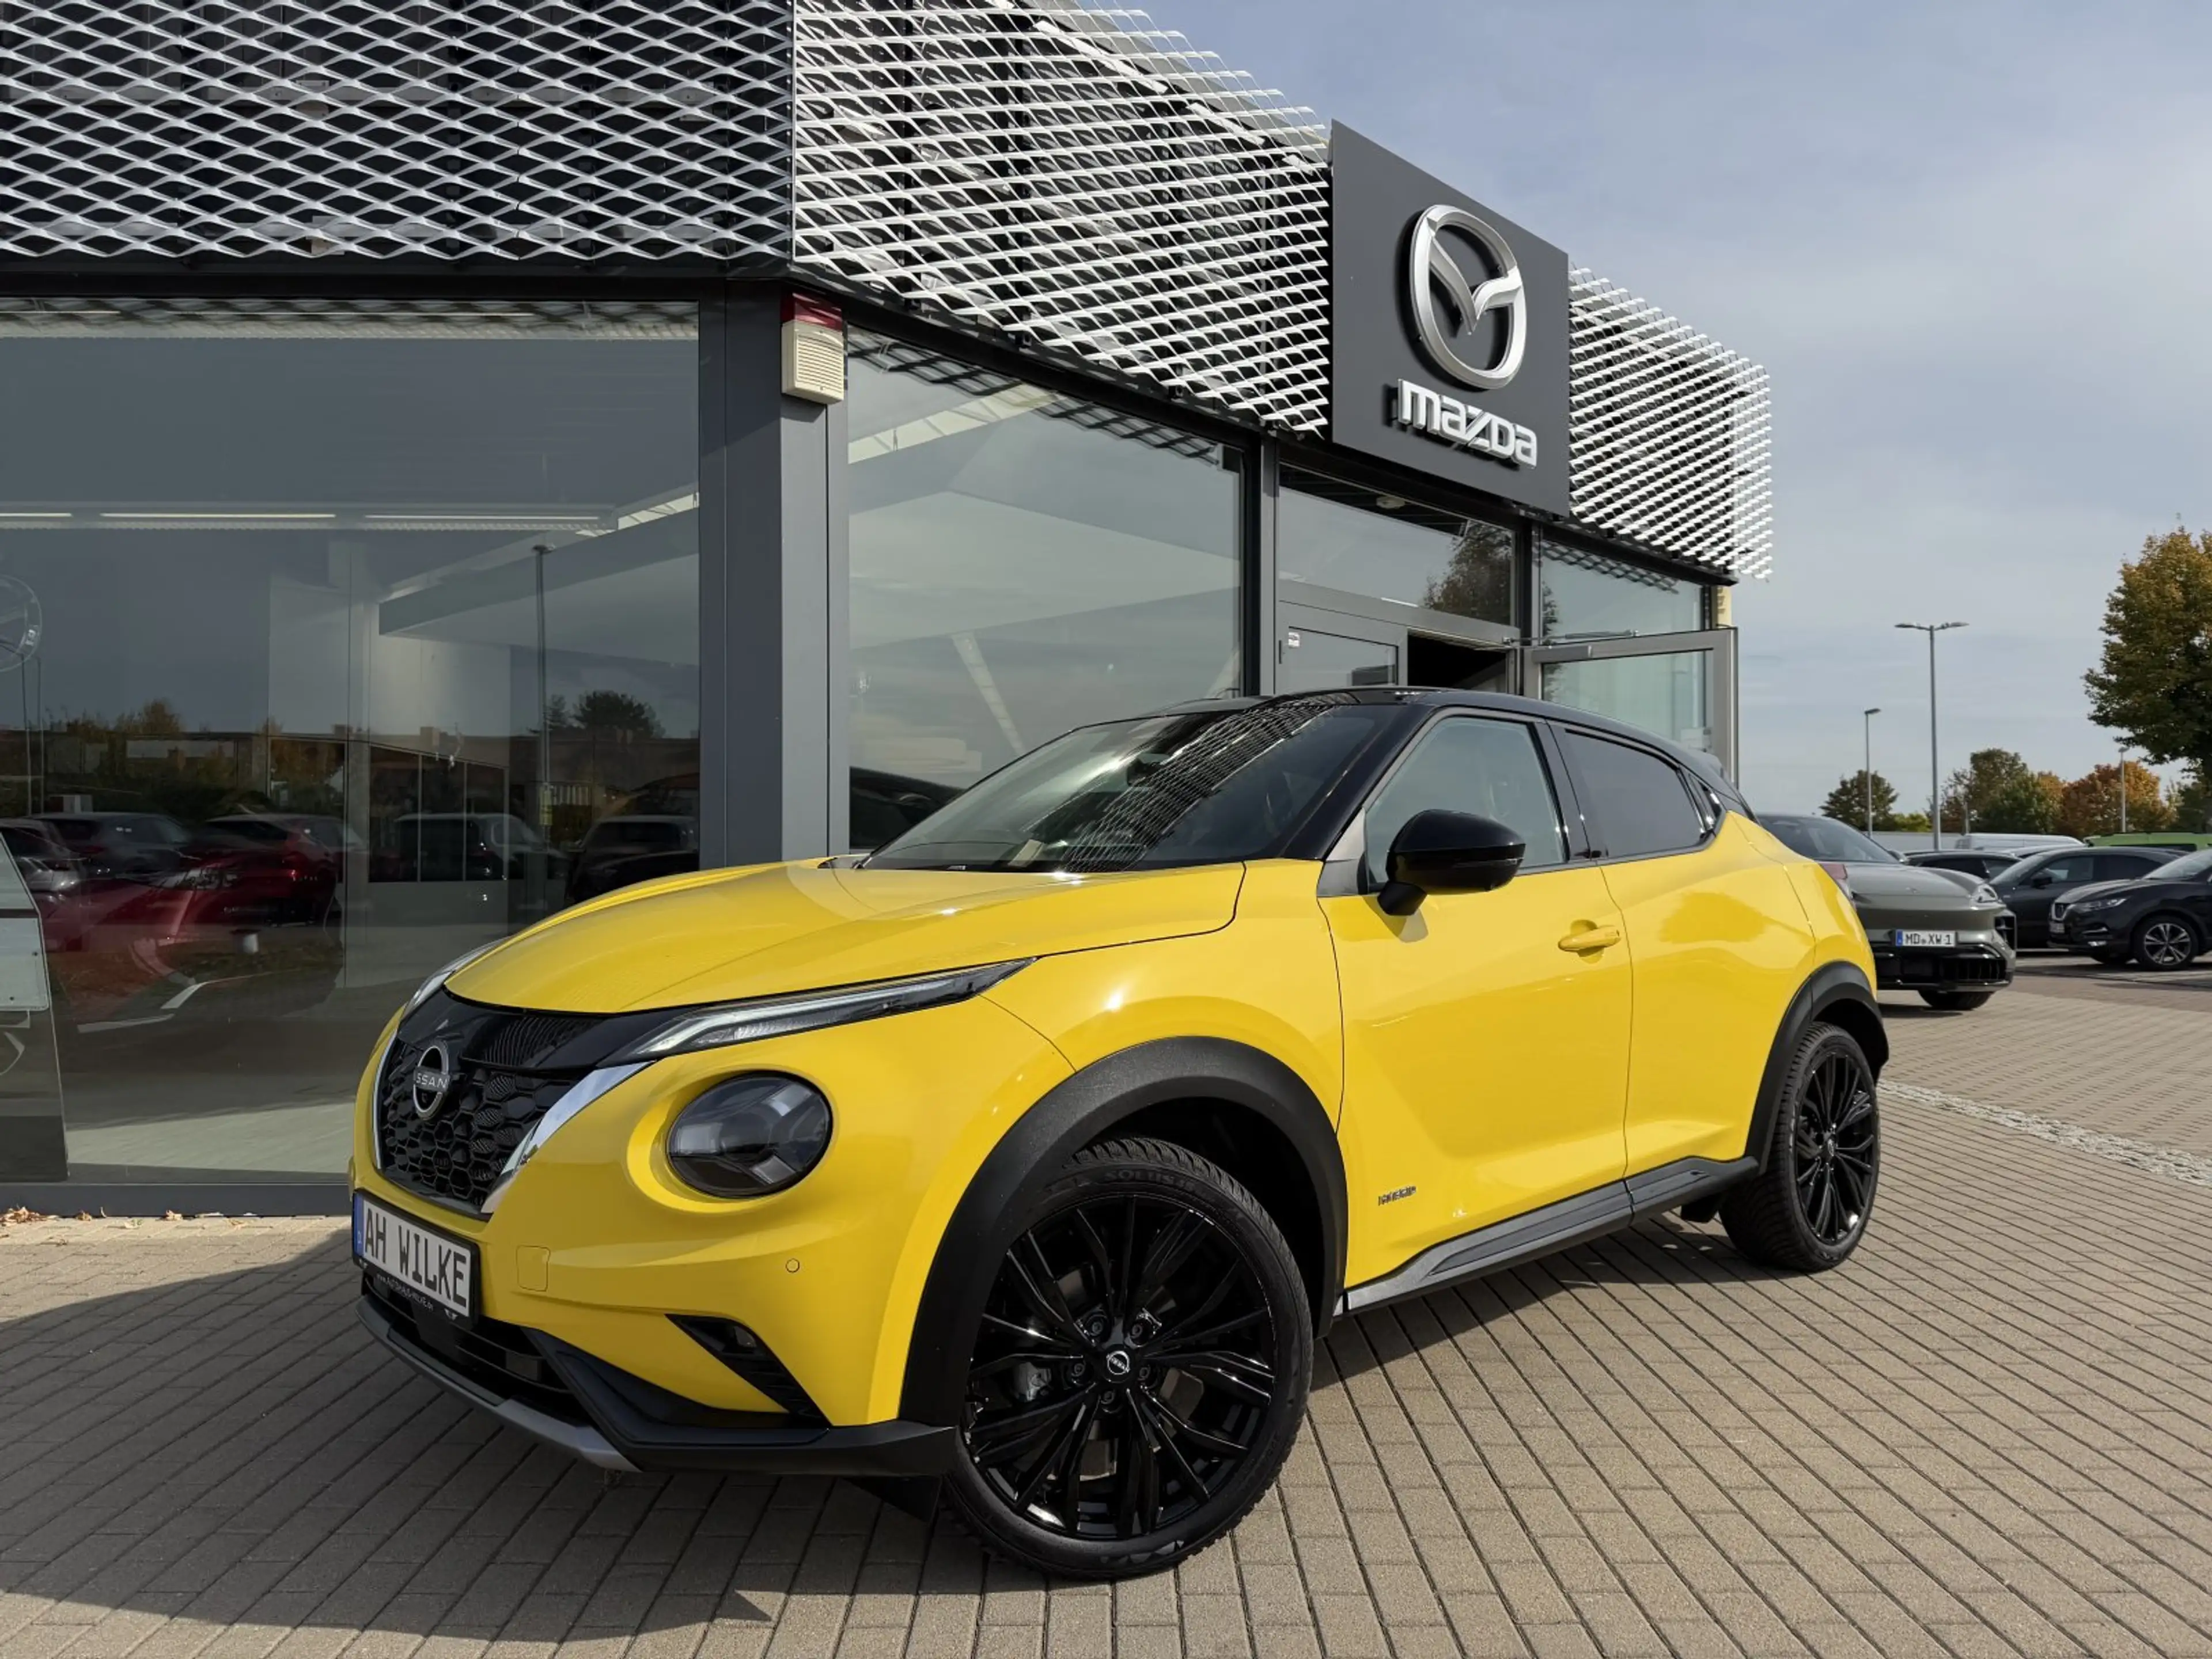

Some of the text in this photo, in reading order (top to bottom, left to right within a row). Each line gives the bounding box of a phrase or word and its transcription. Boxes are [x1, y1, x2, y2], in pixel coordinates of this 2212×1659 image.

[1905, 933, 1920, 945] MD
[1928, 933, 1942, 945] XW
[365, 1207, 387, 1264] AH
[398, 1224, 467, 1309] WILKE
